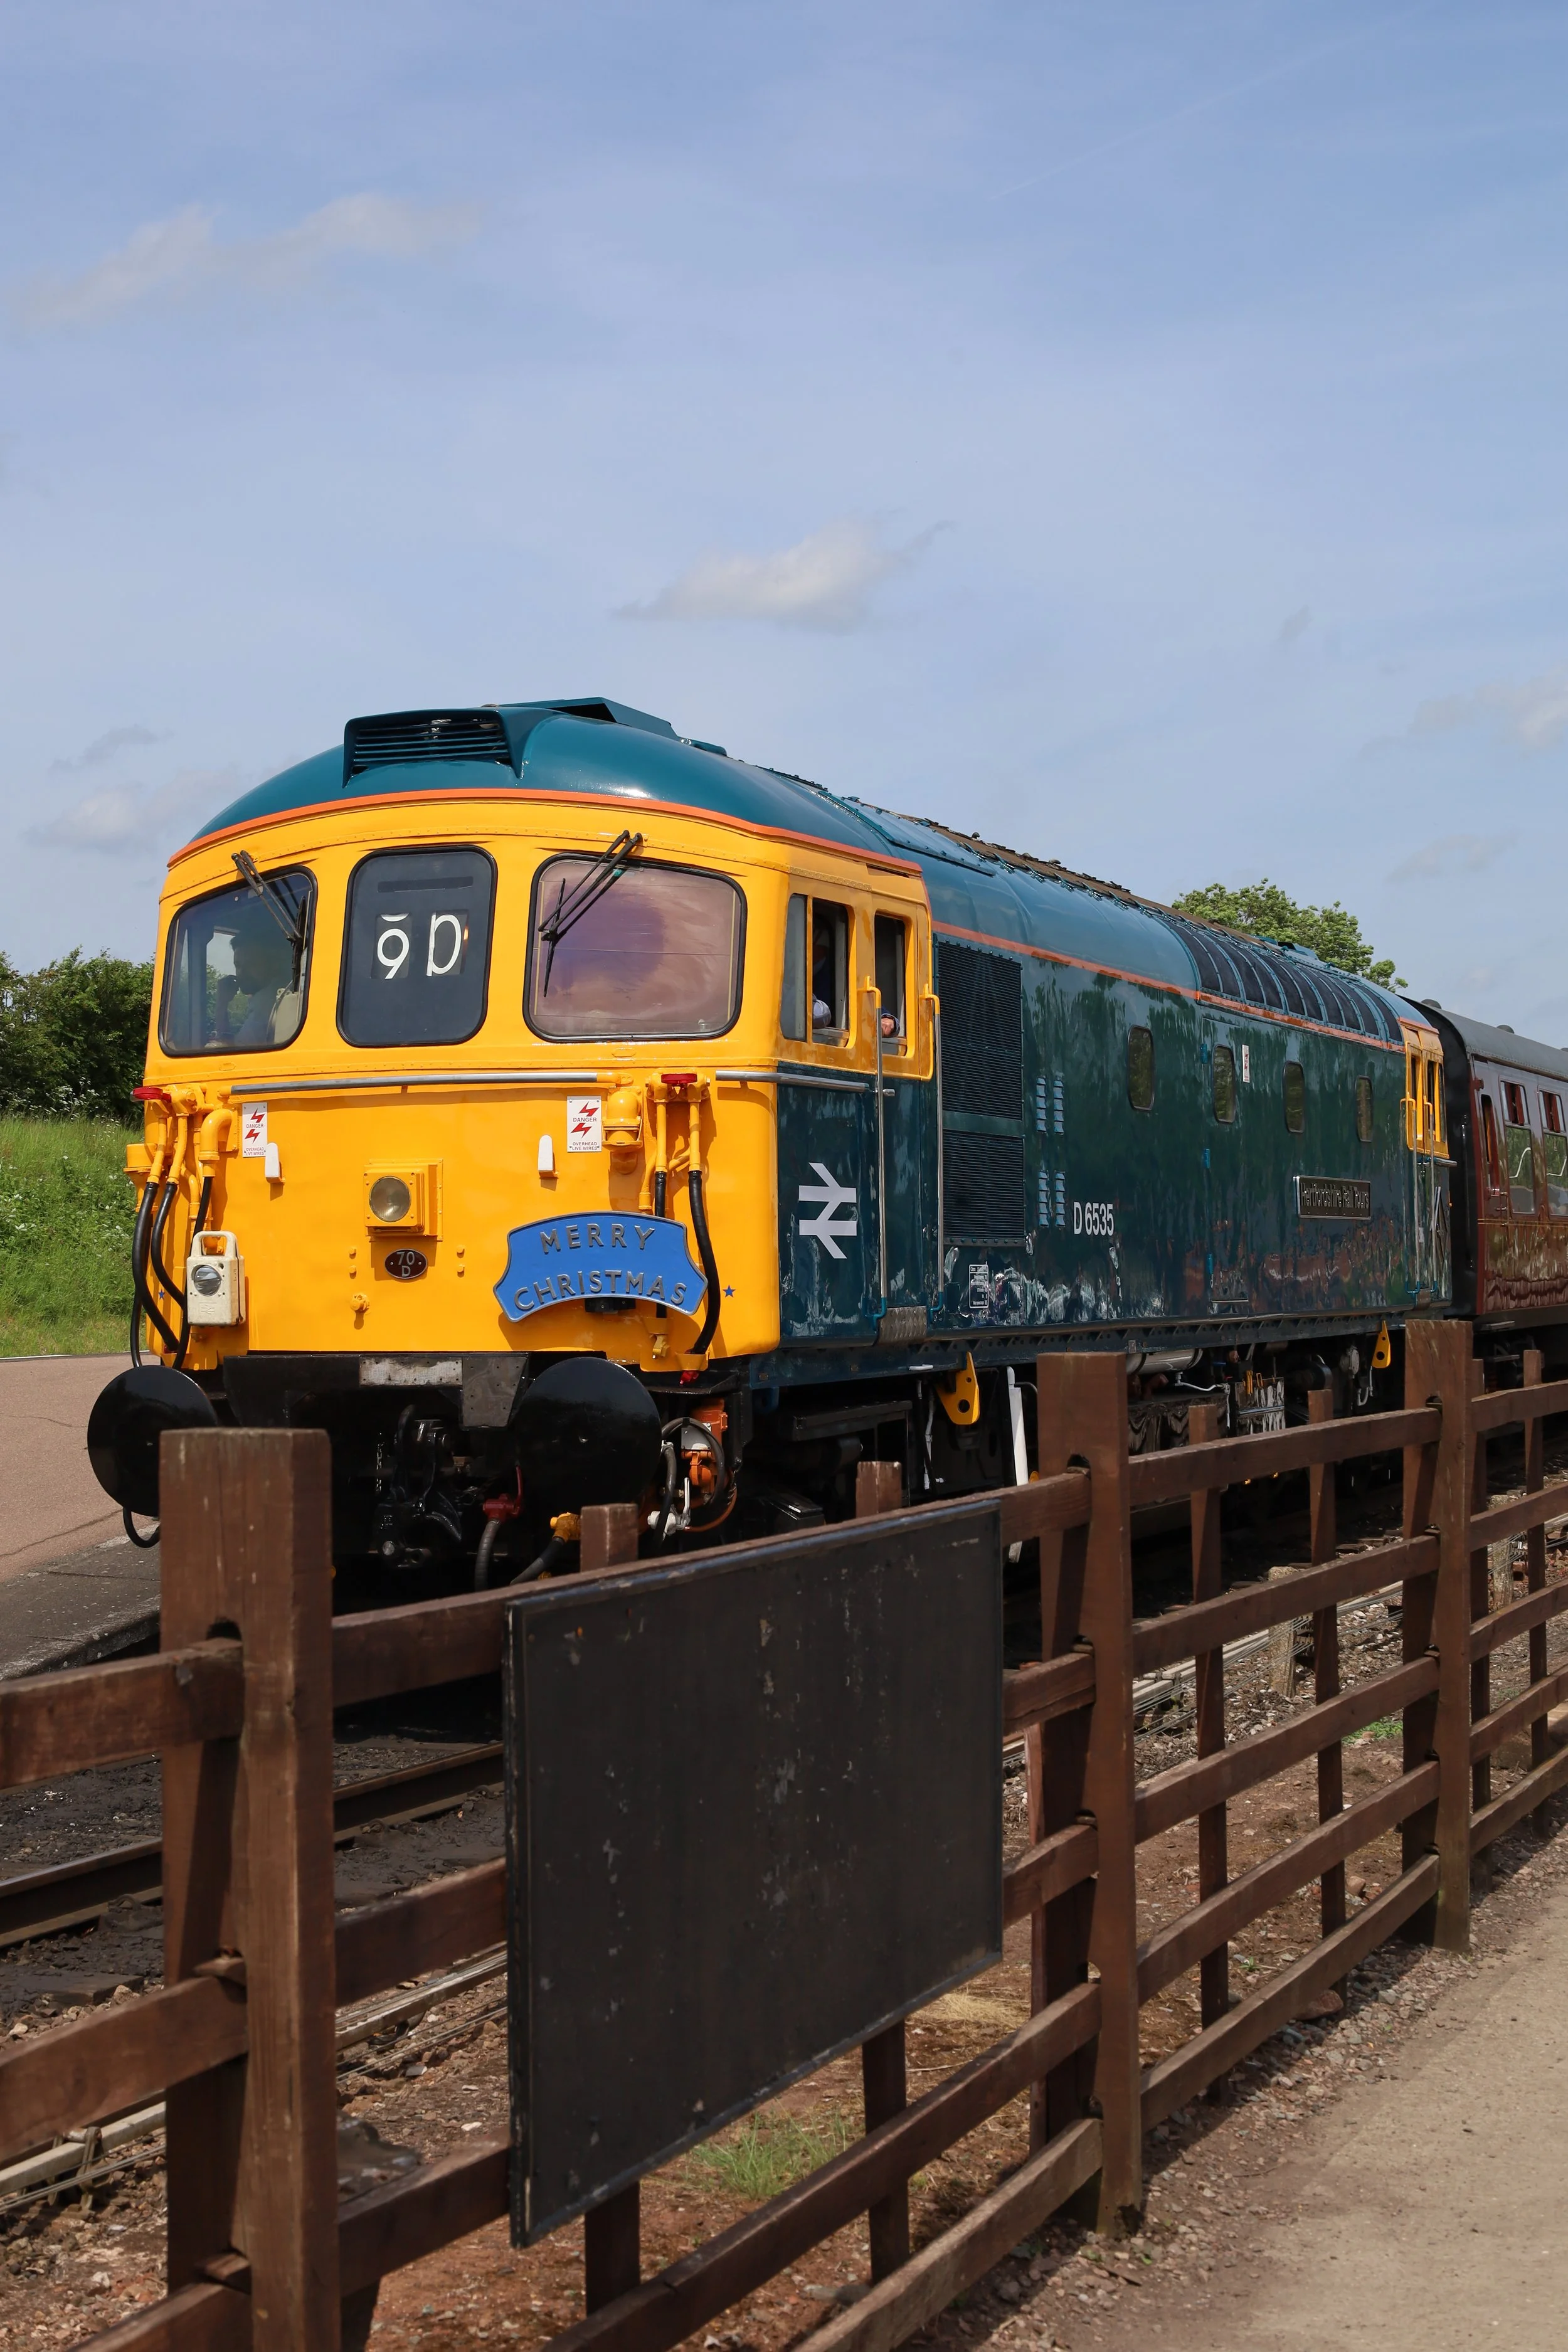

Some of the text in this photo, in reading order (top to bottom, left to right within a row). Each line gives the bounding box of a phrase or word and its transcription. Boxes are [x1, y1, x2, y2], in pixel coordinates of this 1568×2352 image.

[540, 1223, 655, 1254] MERRY
[396, 1251, 415, 1266] 70
[401, 1265, 411, 1277] D
[514, 1269, 687, 1311] CHRISTMAS
